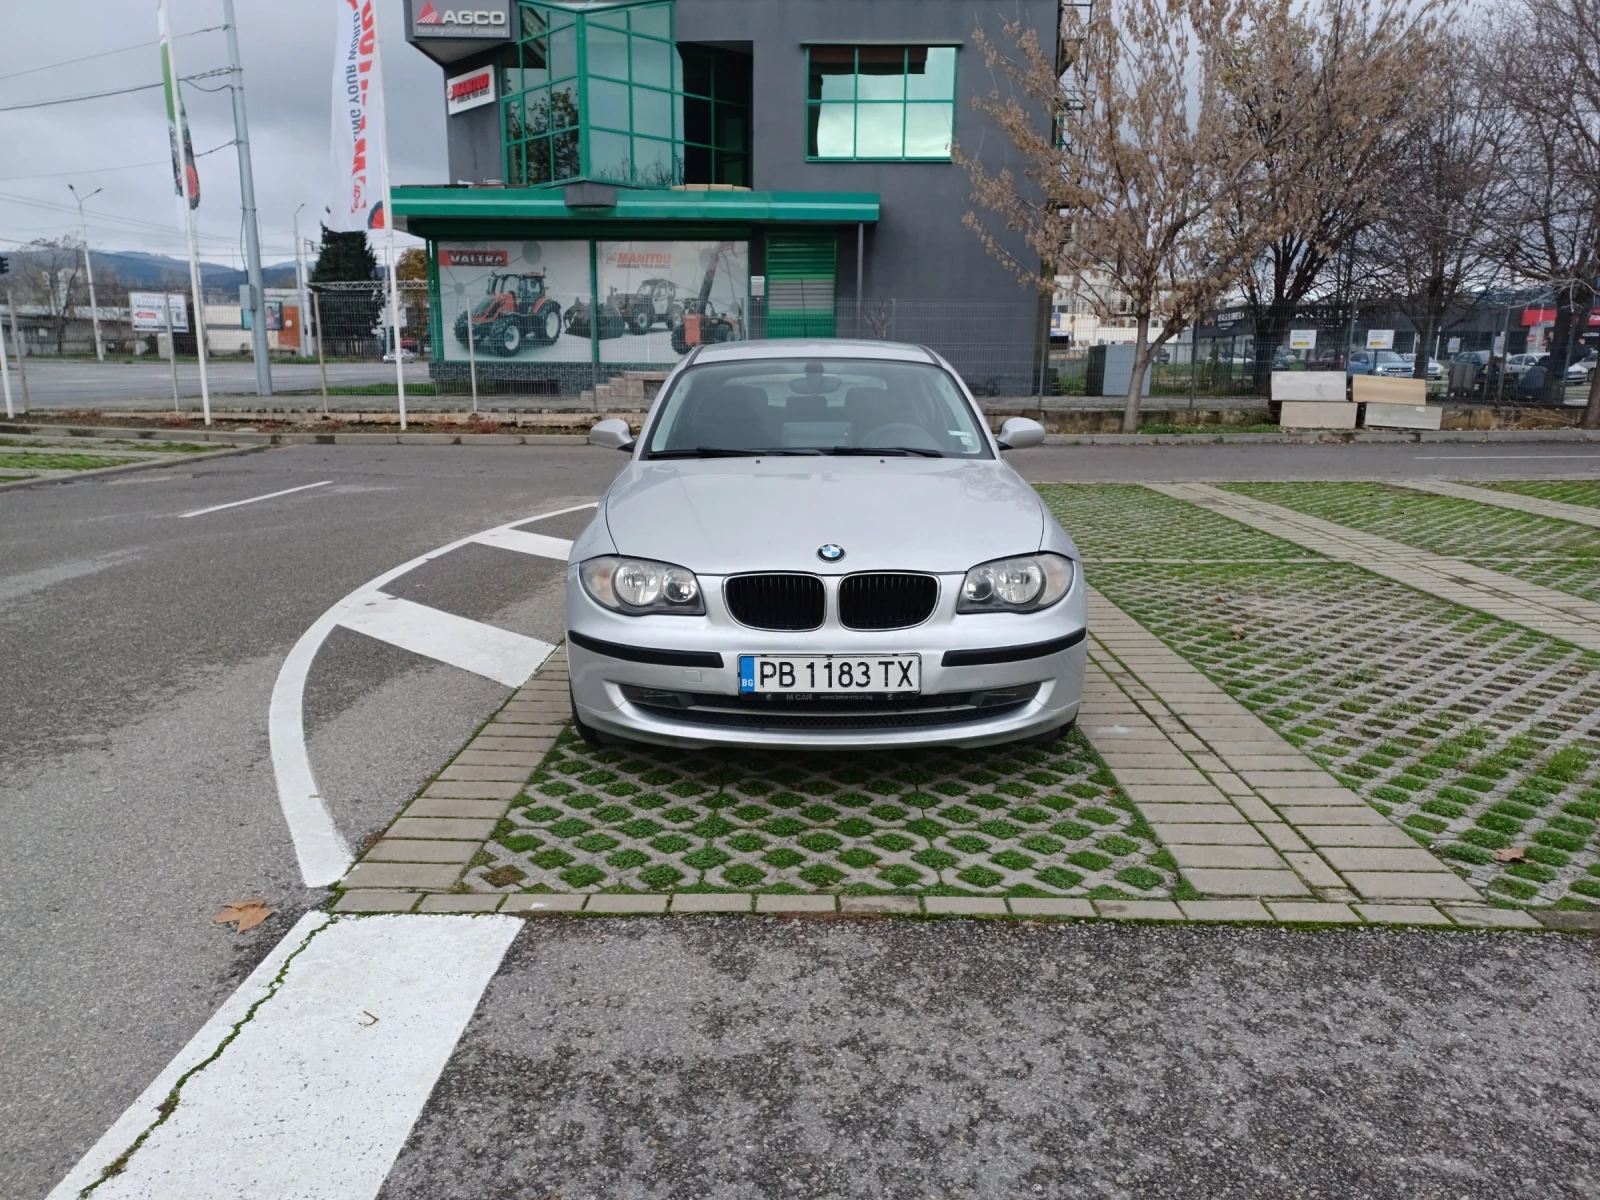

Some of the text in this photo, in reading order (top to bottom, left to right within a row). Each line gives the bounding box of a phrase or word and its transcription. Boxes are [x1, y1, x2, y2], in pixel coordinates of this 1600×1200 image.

[442, 10, 506, 25] AGCO
[474, 27, 506, 36] Company
[449, 252, 505, 265] VALTRA
[617, 252, 671, 264] MANITOU
[760, 660, 913, 688] PB 1183 TX
[742, 679, 754, 687] BG
